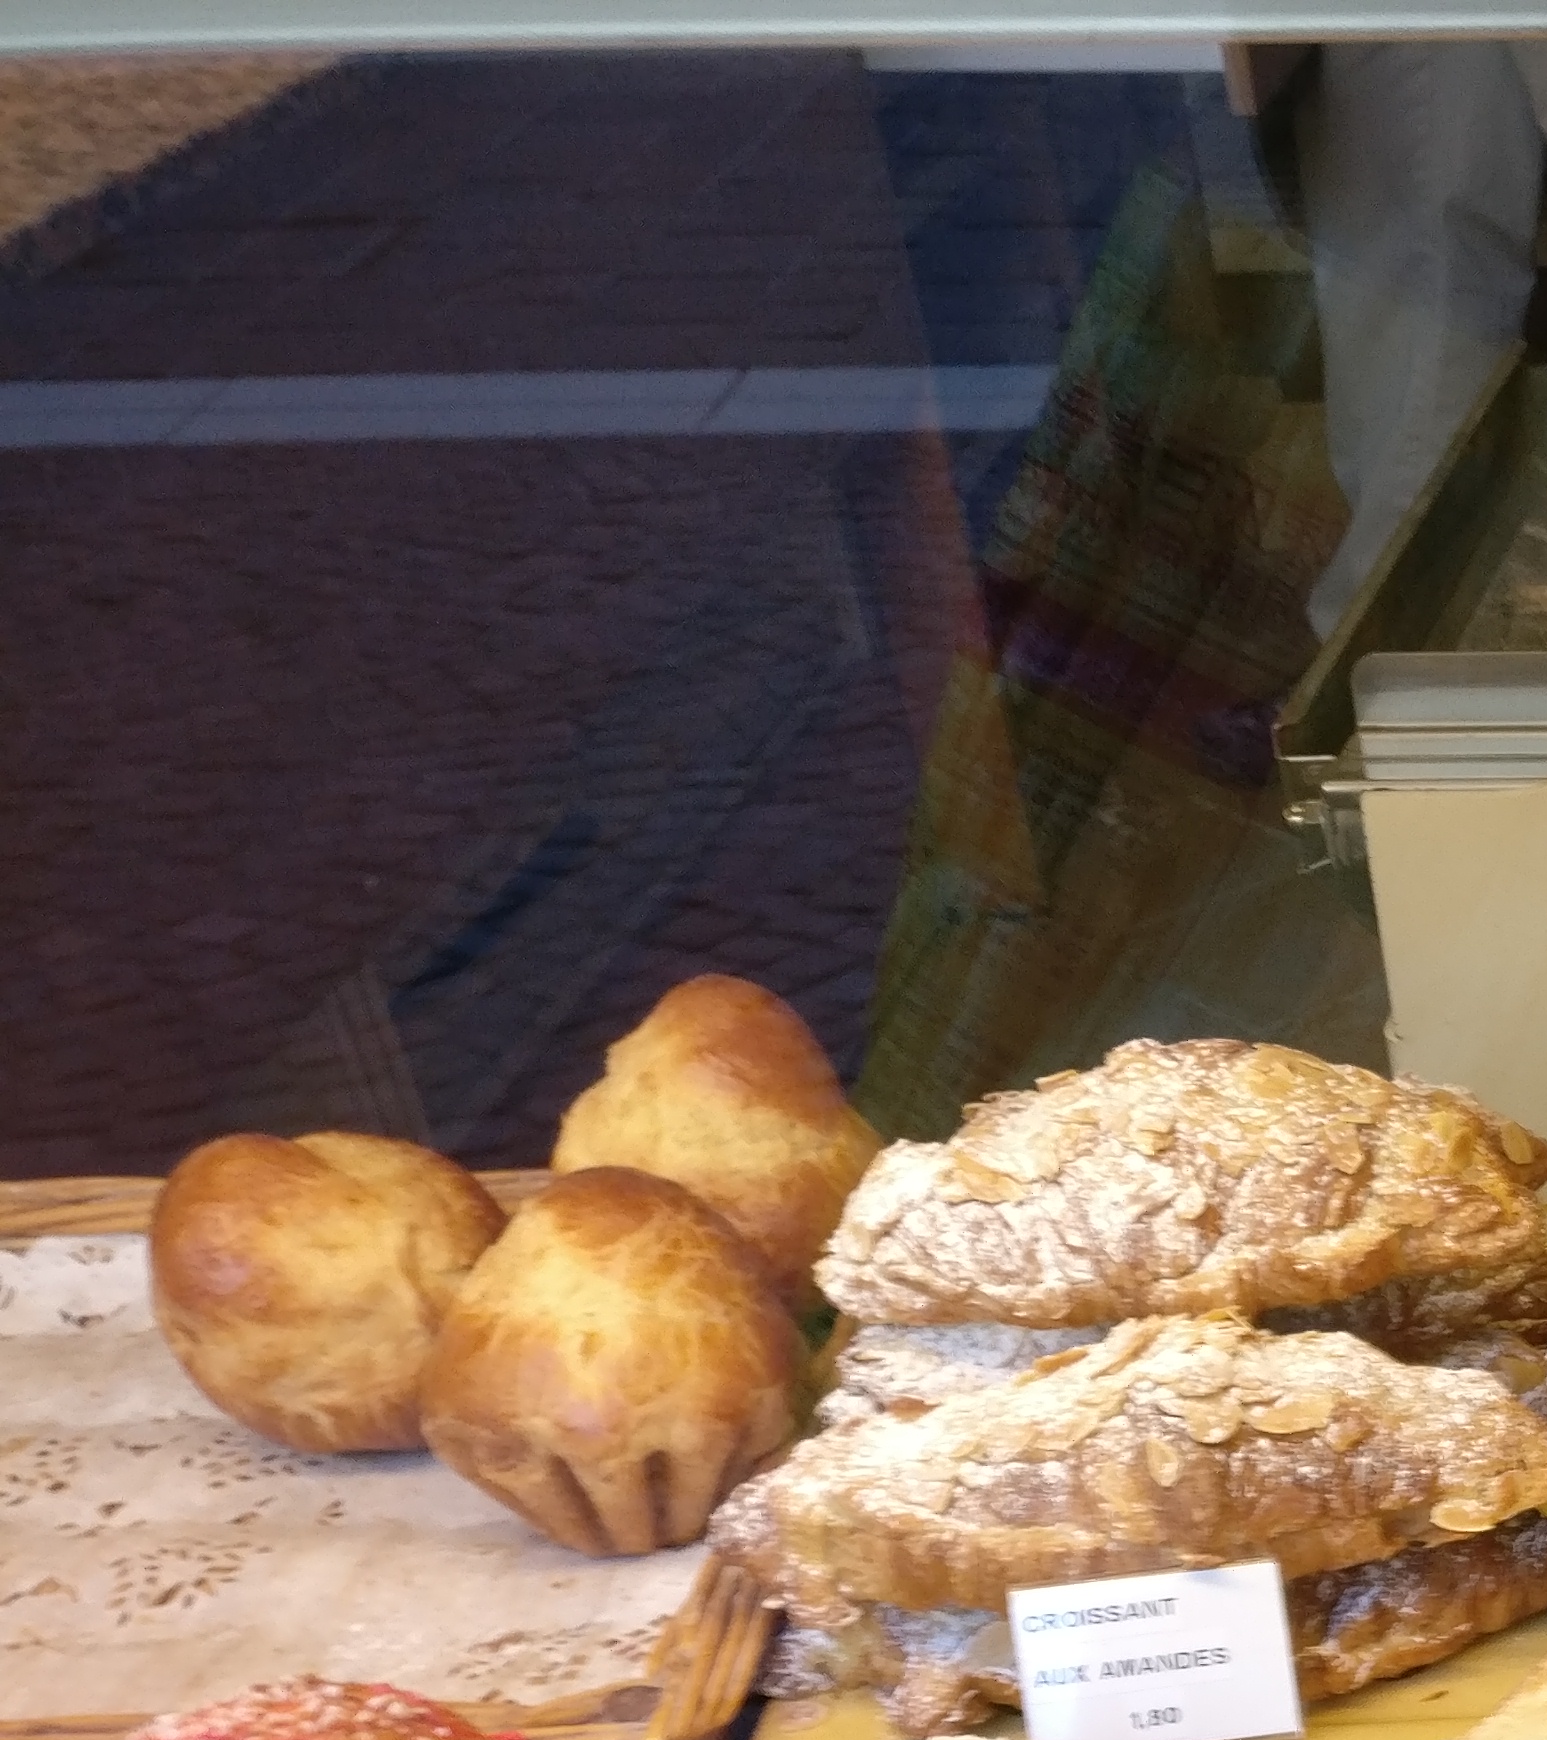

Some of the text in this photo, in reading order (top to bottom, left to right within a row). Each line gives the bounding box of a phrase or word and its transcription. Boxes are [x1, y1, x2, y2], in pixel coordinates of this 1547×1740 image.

[1022, 1597, 1179, 1633] CROISSANT
[1033, 1647, 1231, 1688] AUX AMANDES
